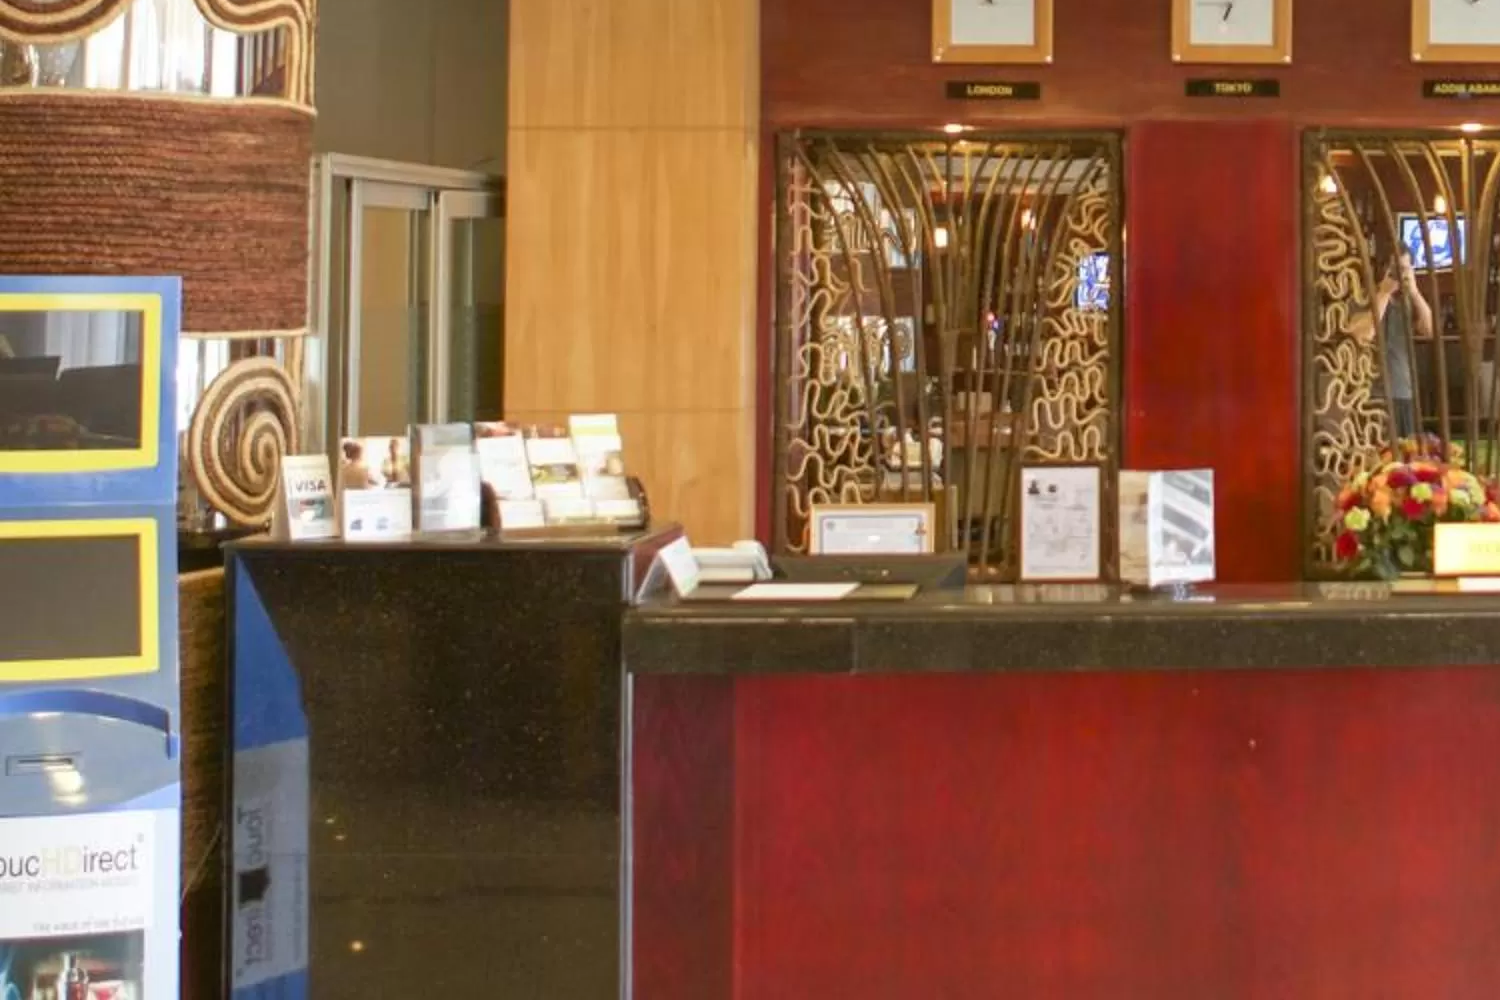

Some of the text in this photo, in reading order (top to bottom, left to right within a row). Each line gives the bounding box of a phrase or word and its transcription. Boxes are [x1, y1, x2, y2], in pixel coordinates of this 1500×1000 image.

[966, 84, 1013, 96] LONDON
[1214, 81, 1252, 93] TOKYO
[295, 479, 327, 492] VISA
